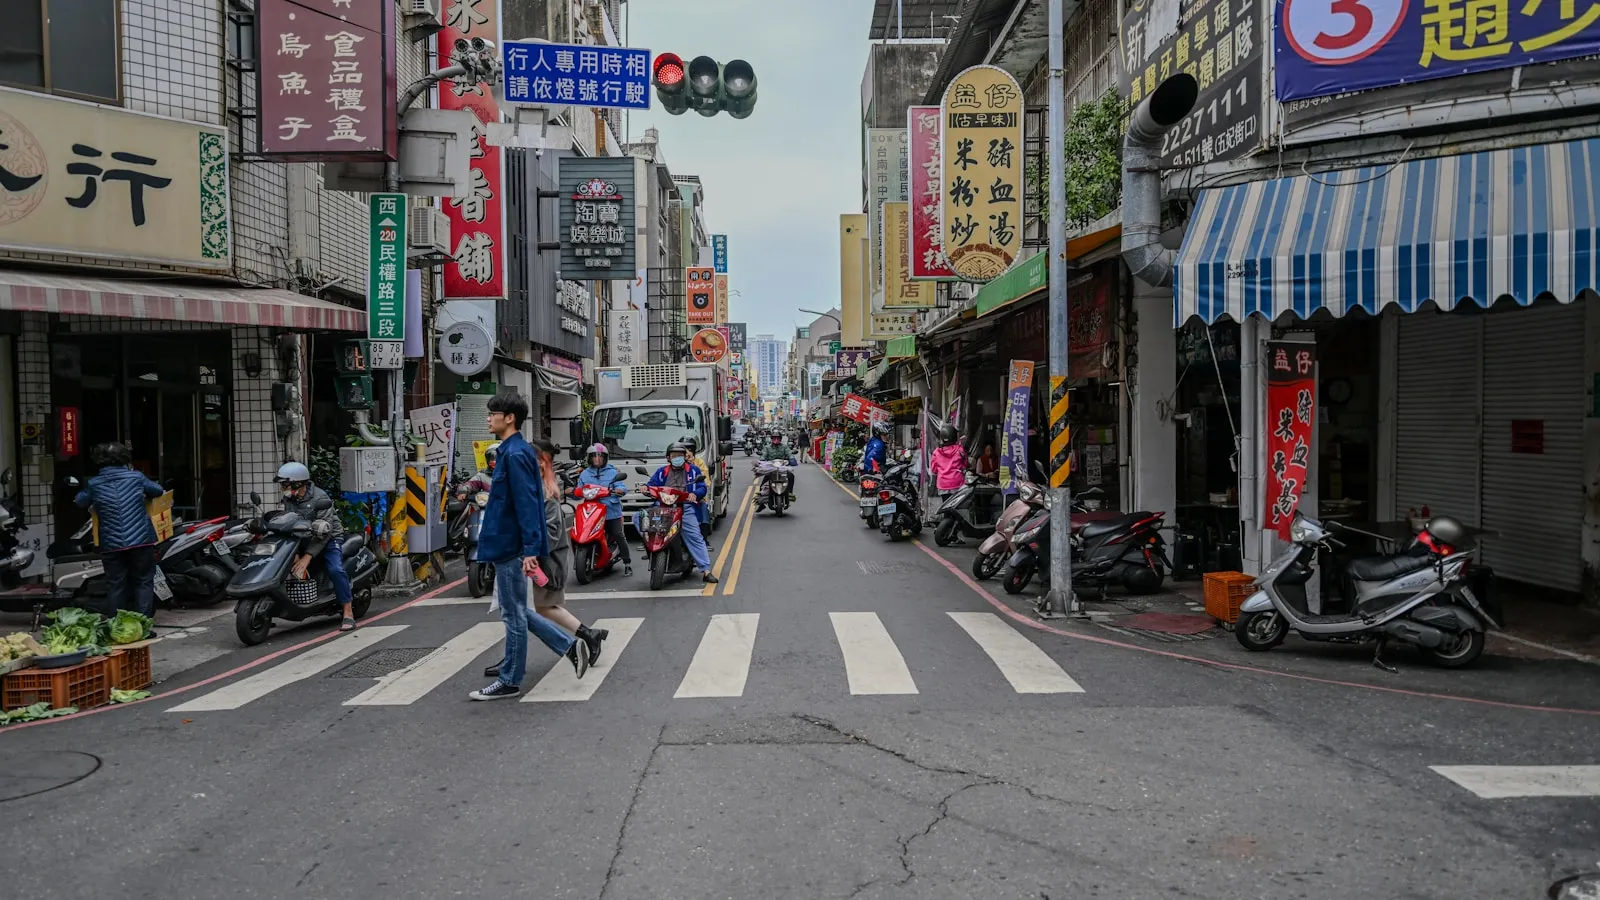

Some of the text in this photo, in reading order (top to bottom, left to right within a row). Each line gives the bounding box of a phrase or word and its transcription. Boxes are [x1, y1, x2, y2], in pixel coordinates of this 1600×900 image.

[508, 47, 646, 77] 行人專用時相
[277, 33, 312, 140] 烏魚子
[325, 31, 366, 142] 食品禮盒
[508, 75, 645, 104] 請依燈號行駛
[950, 83, 1017, 109] 益仔
[958, 113, 1007, 127] 古早味
[949, 138, 979, 247] 米粉炒
[986, 137, 1017, 247] 豬血湯
[379, 198, 397, 215] 西
[575, 201, 621, 224] 淘寶
[379, 230, 397, 241] 220
[378, 244, 397, 337] 民權路三段
[372, 344, 400, 353] 89 78
[1273, 349, 1313, 374] 益仔
[372, 357, 400, 367] 47 44
